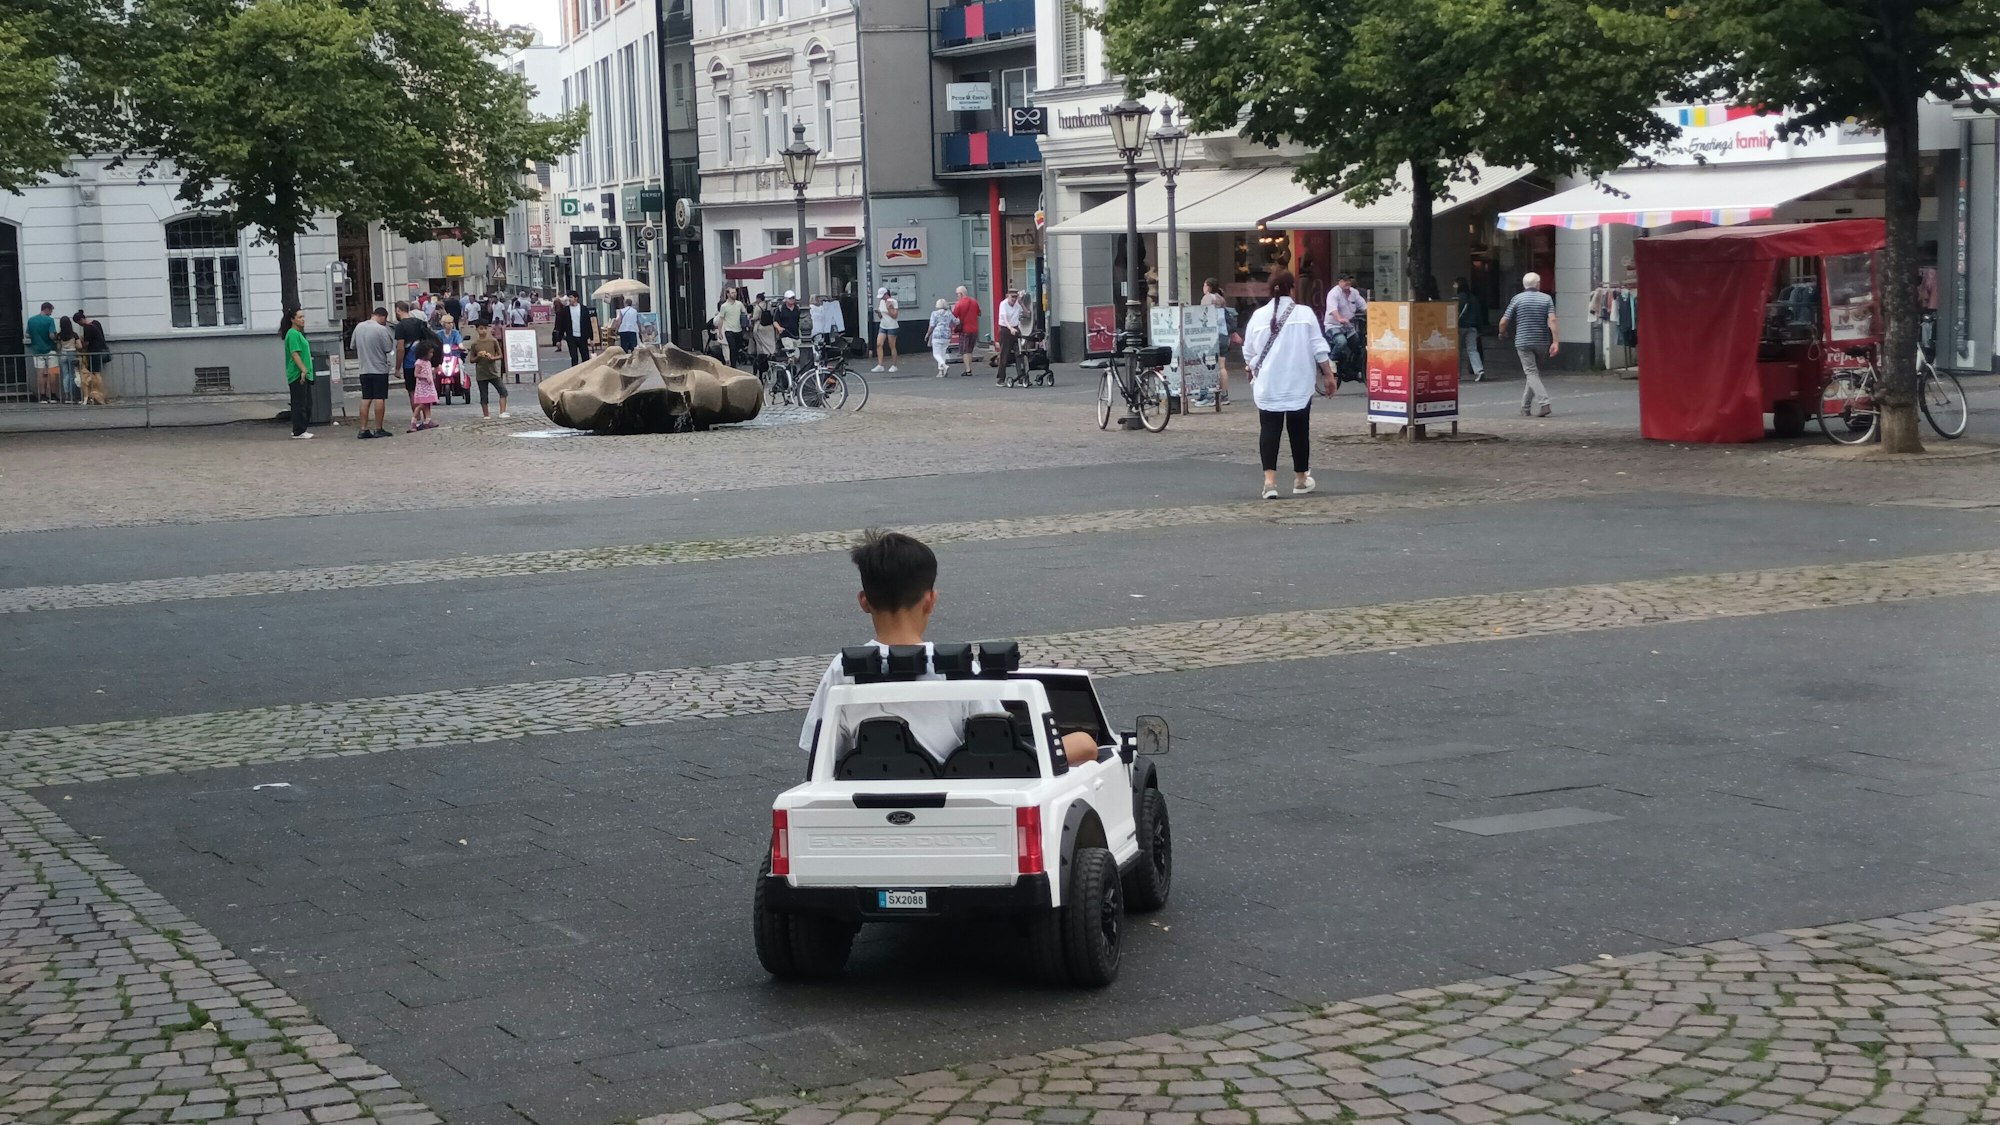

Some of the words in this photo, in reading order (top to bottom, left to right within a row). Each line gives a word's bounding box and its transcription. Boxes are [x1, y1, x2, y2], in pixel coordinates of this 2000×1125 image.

[891, 232, 918, 250] dm
[890, 813, 911, 824] Ford
[809, 835, 909, 847] SUPER
[916, 835, 996, 847] DUTY
[888, 895, 924, 905] SX2088
